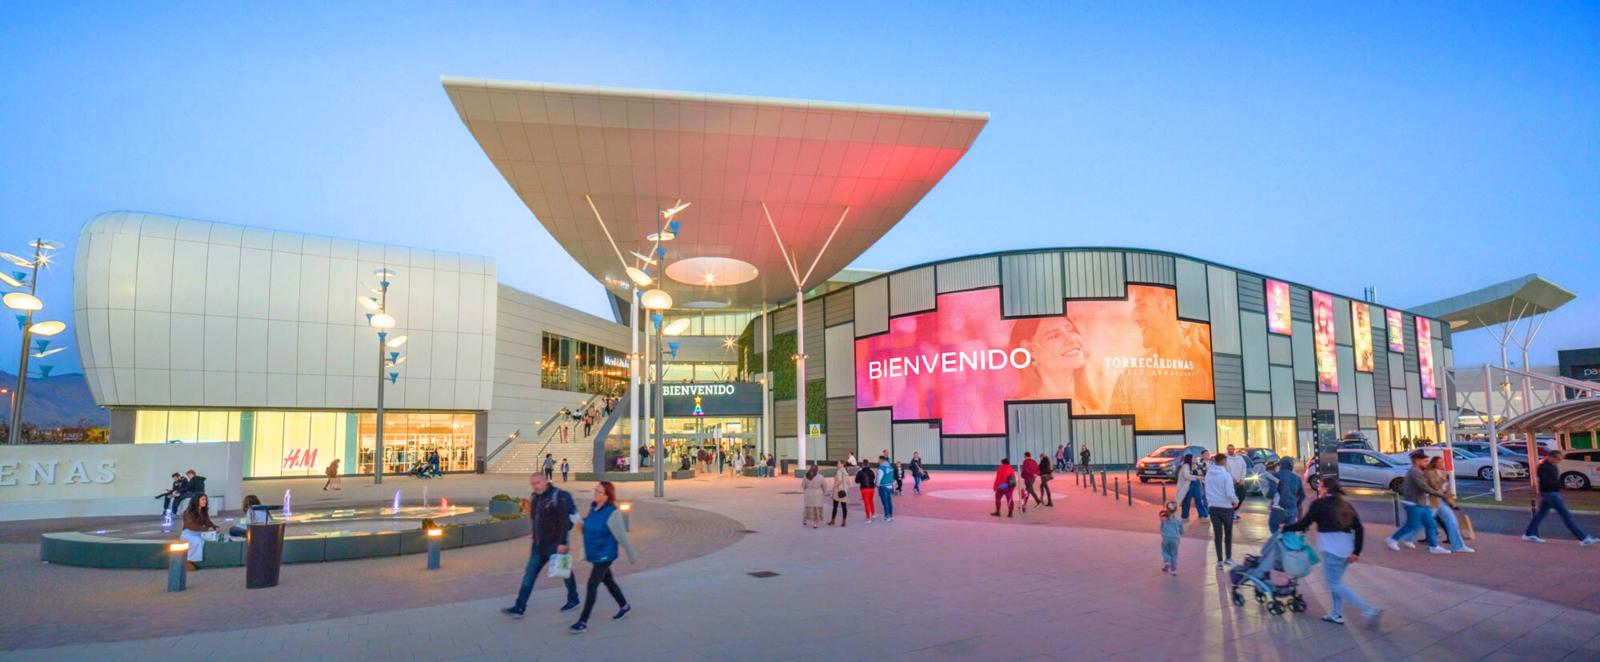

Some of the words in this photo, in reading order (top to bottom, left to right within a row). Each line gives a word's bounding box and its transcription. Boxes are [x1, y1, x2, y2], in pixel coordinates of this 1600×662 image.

[869, 347, 1032, 380] BIENVENIDO
[662, 384, 735, 396] BIENVENIDO
[283, 448, 319, 469] H&M
